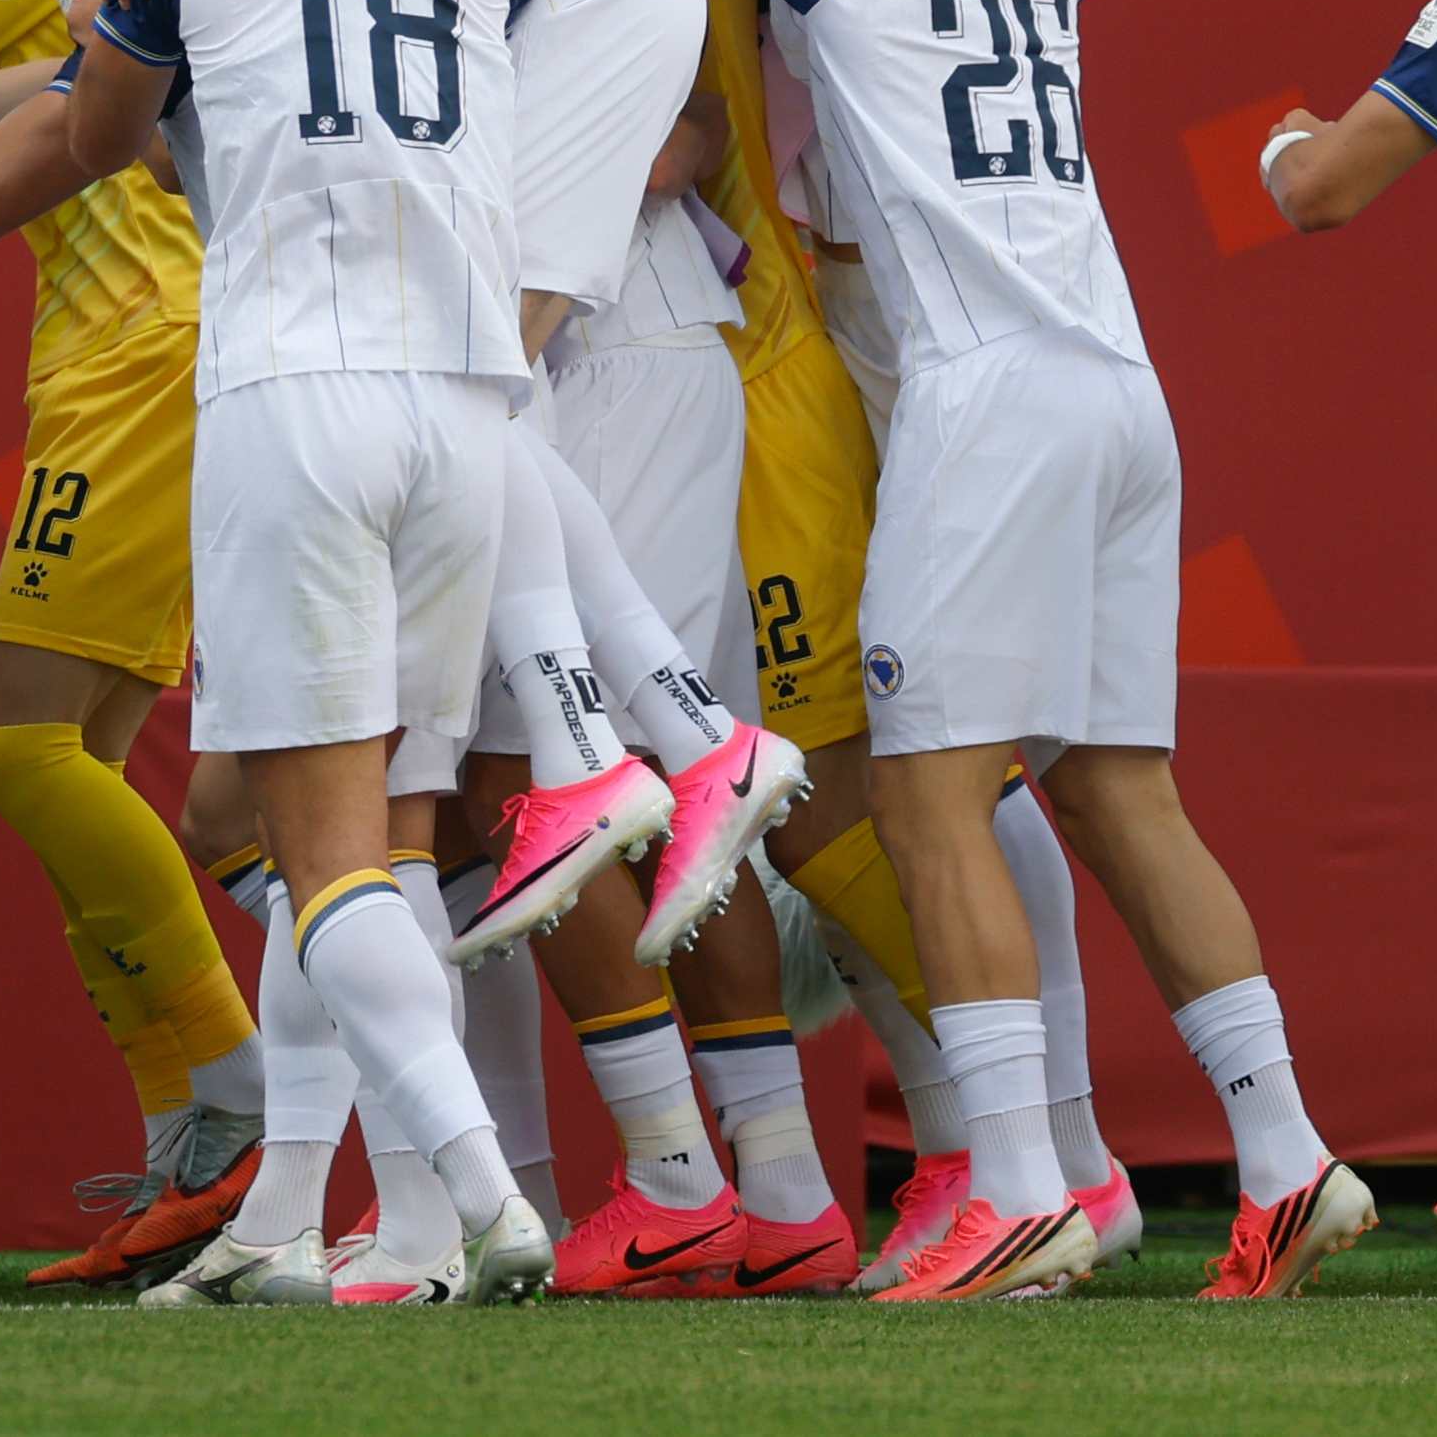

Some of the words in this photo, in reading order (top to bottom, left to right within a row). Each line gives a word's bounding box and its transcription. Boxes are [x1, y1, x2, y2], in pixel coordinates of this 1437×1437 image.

[14, 467, 91, 560] 12
[10, 586, 50, 603] KELME
[549, 672, 604, 771] TAPEDESIGN
[663, 677, 725, 745] TAPEDESIGN
[768, 694, 811, 713] KELME
